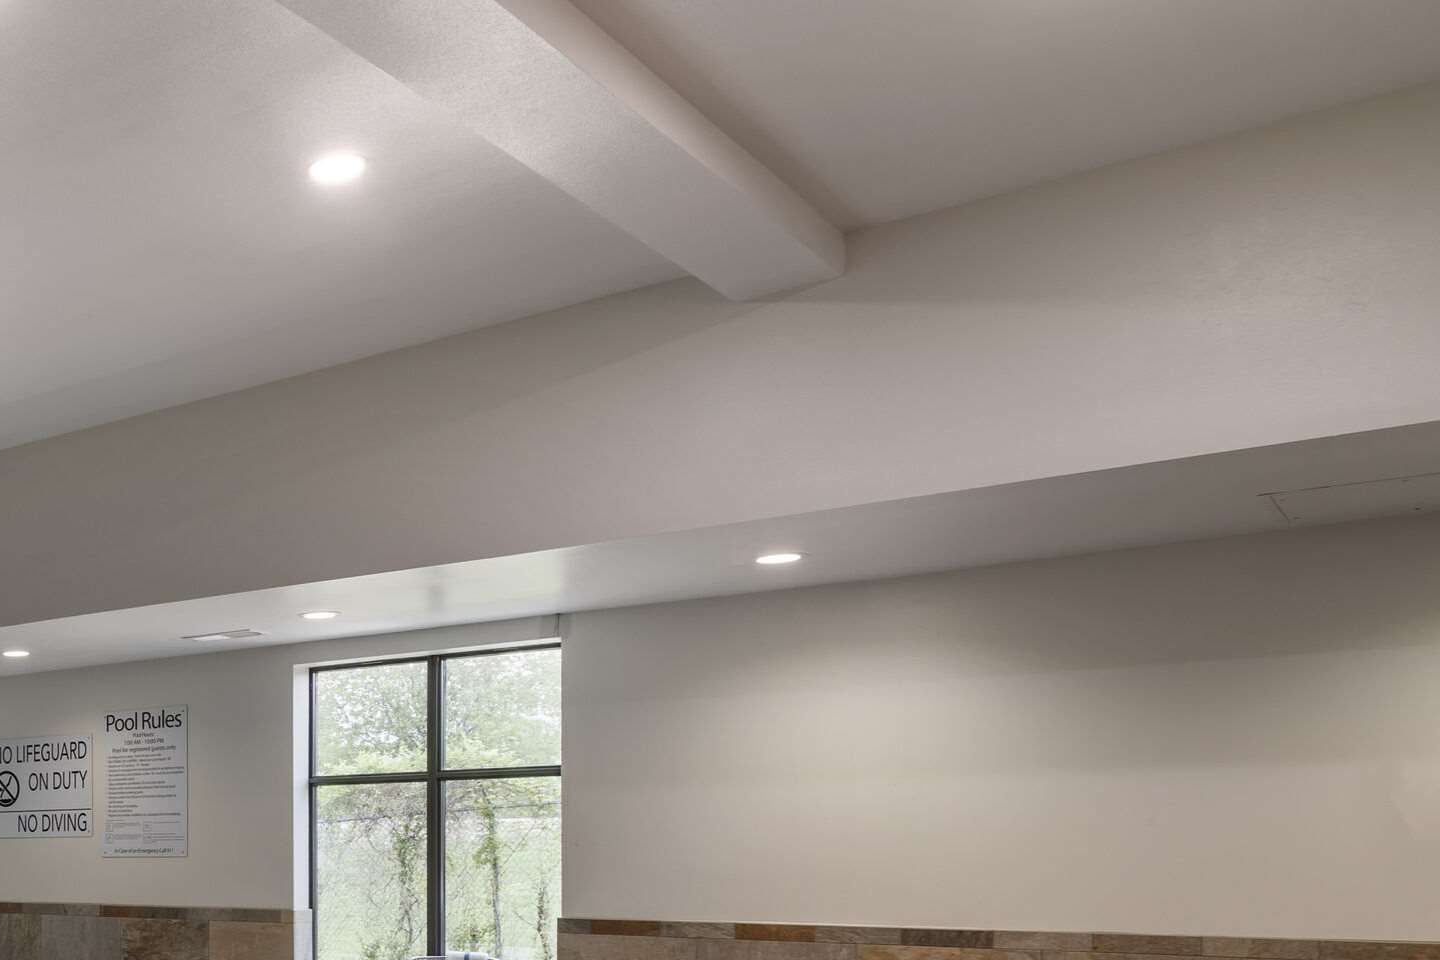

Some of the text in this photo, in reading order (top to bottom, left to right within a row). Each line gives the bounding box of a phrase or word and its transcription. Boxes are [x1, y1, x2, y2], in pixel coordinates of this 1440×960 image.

[106, 710, 182, 732] Pool Rules
[16, 741, 87, 763] LIFEGUARD
[29, 770, 87, 791] ON DUTY
[18, 814, 38, 832] NO
[41, 812, 87, 832] DIVING
